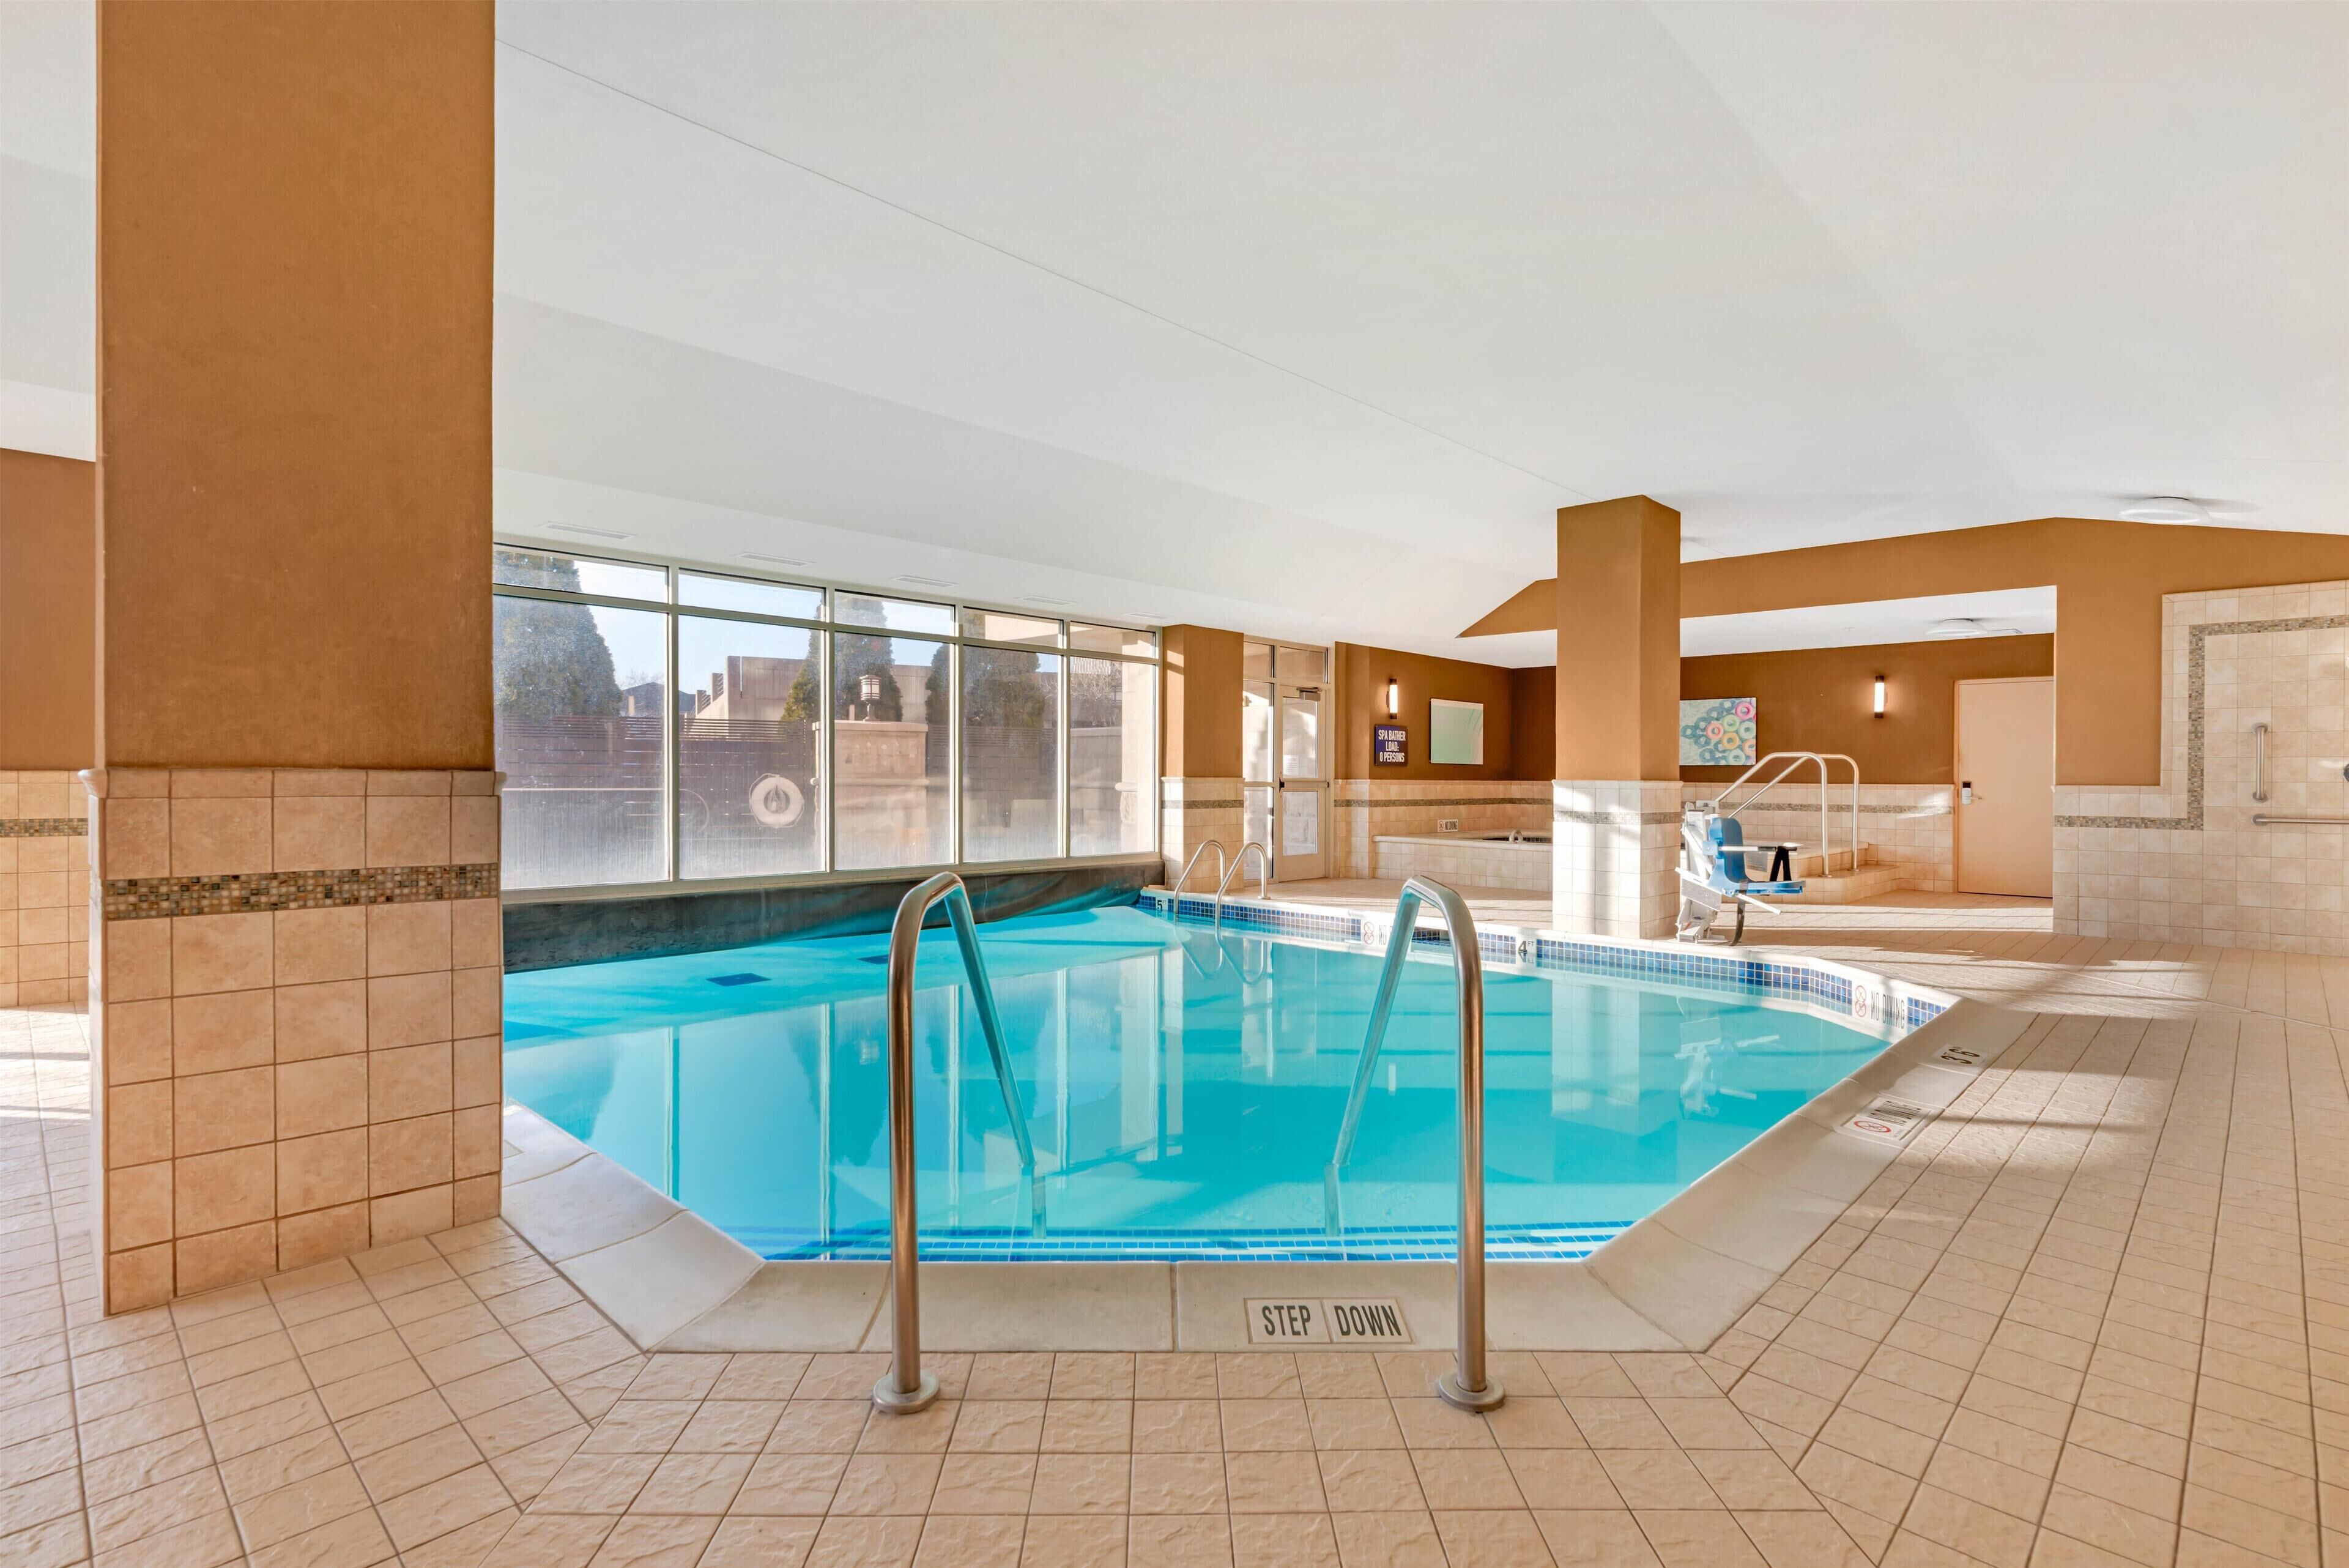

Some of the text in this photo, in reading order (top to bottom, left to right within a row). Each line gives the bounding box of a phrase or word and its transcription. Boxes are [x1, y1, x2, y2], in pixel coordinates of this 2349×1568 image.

[1378, 730, 1406, 741] SPA BATHER
[1386, 741, 1399, 751] LOAD:
[1379, 752, 1405, 762] 8 PERSONS
[1157, 900, 1162, 911] 5
[1518, 941, 1527, 952] 4
[1871, 990, 1904, 1014] NO DIVING
[1262, 1305, 1402, 1336] STEP DOWN
